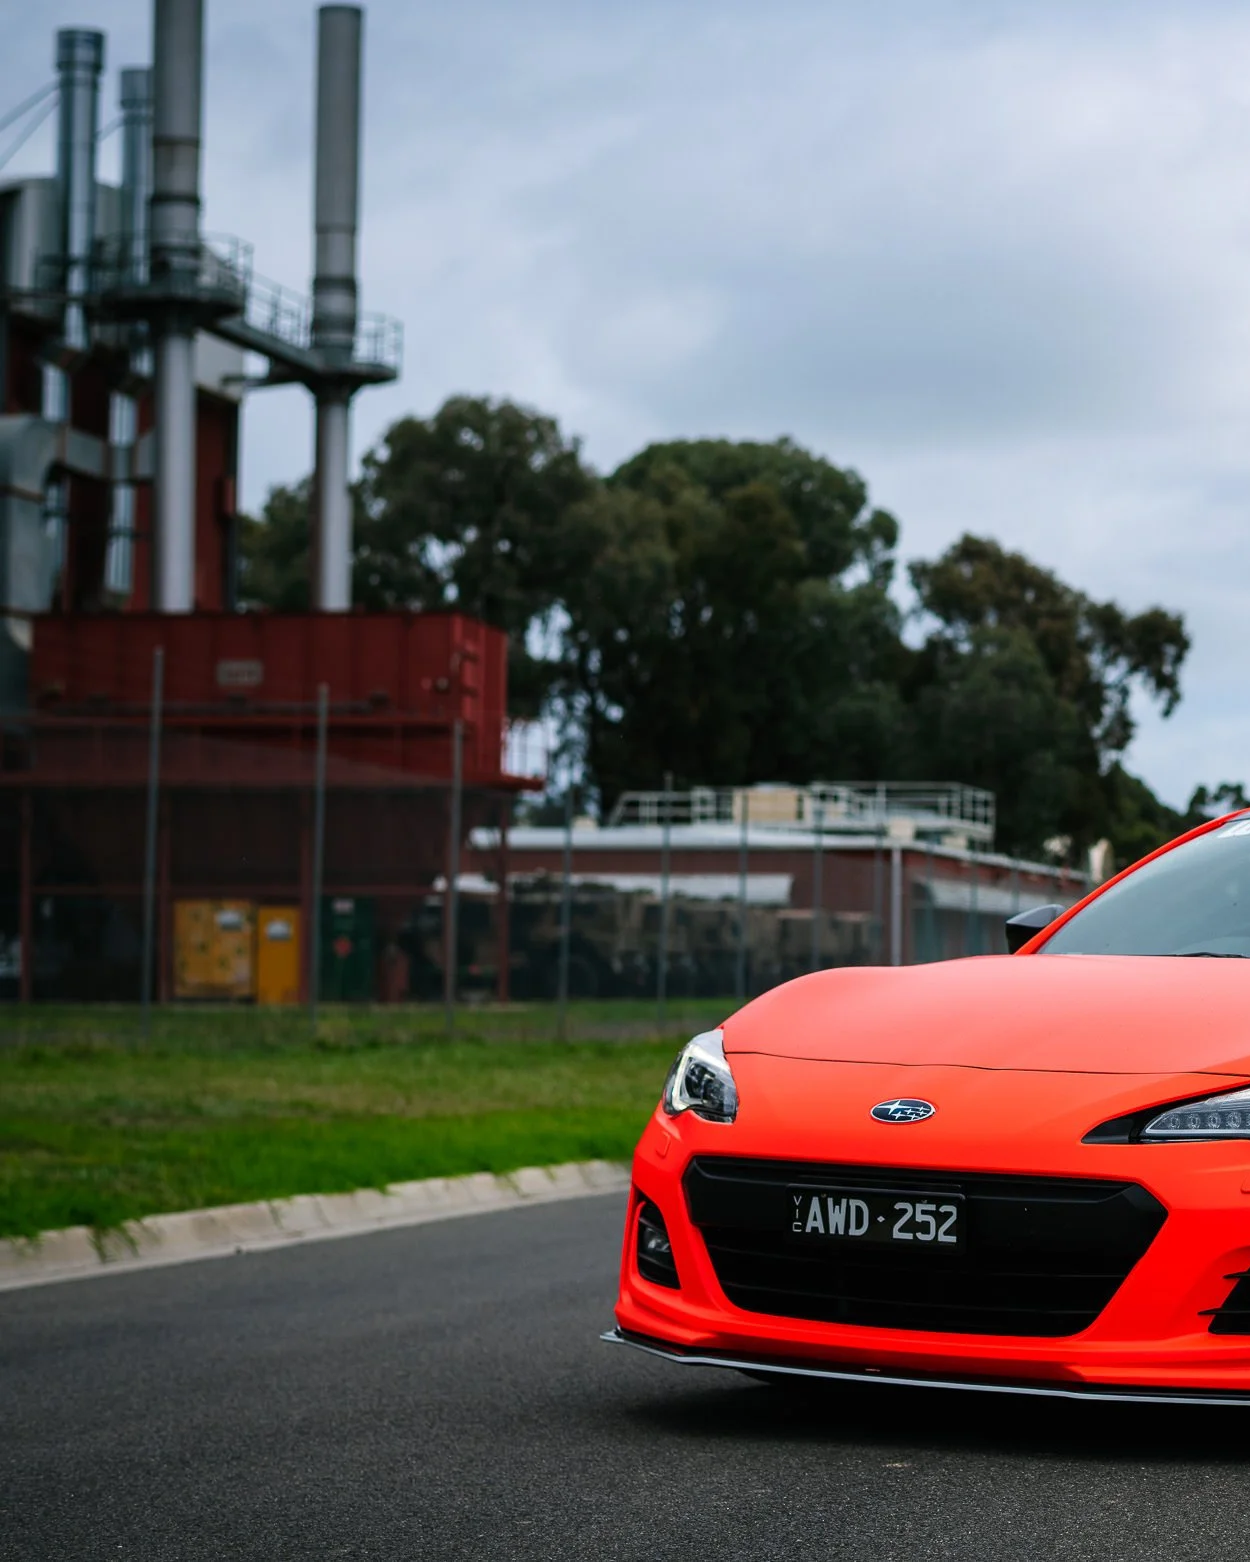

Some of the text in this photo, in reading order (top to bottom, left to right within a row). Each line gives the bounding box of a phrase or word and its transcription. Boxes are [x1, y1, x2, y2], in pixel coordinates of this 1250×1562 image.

[792, 1195, 802, 1232] VIC
[805, 1196, 957, 1243] AWD 252
